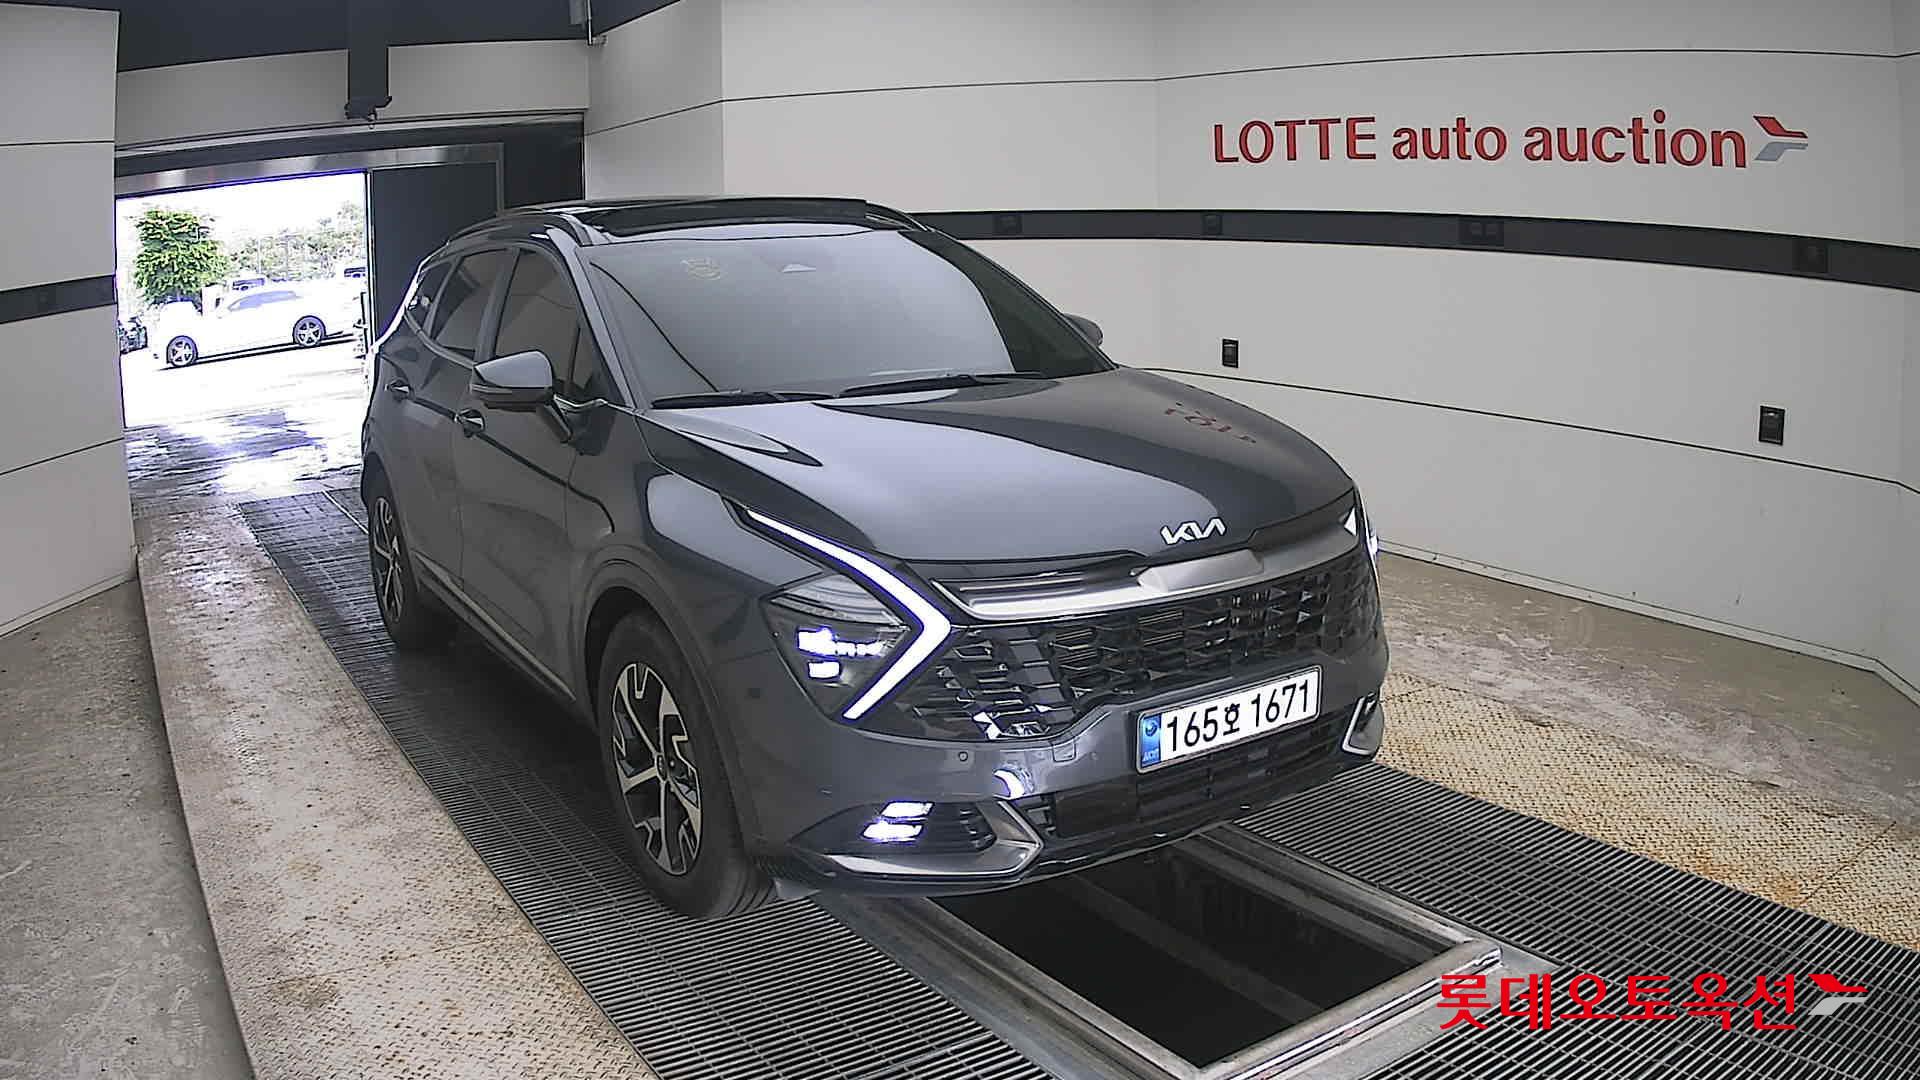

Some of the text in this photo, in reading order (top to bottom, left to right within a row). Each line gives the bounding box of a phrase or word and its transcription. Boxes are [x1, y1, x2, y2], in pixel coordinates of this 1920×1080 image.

[1214, 109, 1746, 168] LOTTE auto auction
[1251, 679, 1308, 728] 1671
